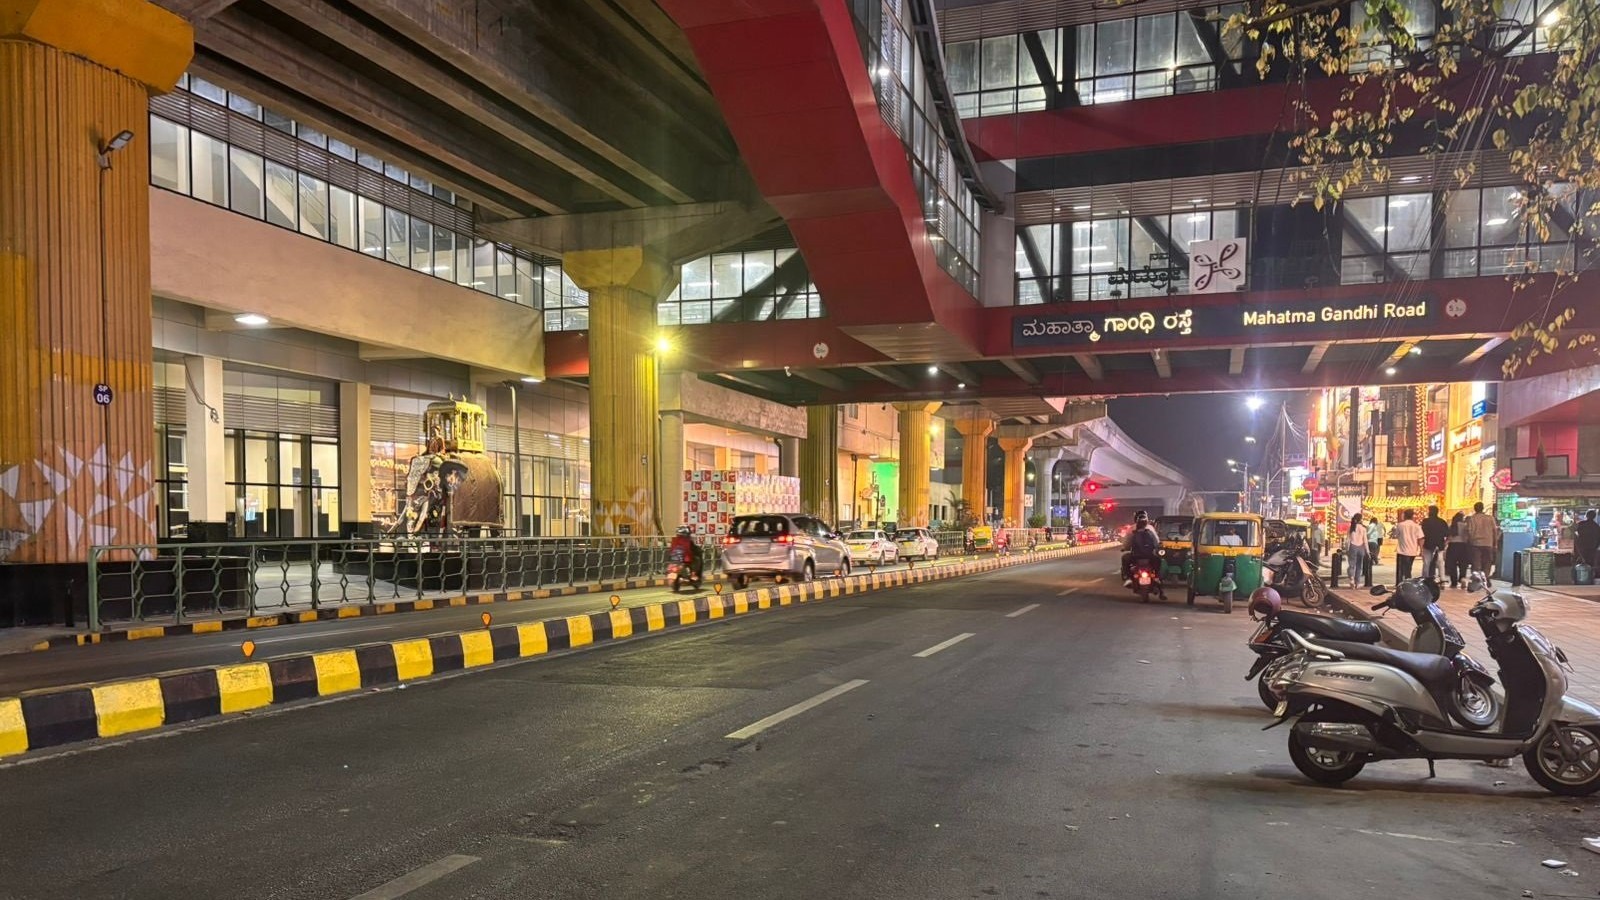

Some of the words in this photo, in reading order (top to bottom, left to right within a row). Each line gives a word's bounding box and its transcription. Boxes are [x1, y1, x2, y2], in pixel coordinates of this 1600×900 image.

[1103, 311, 1156, 334] ಗಾಂಧಿ
[1163, 309, 1193, 335] ರಸ್ತೆ
[1243, 309, 1316, 326] Mahatma
[1321, 304, 1377, 322] Gandhi
[1384, 301, 1426, 318] Road
[96, 393, 110, 404] 06
